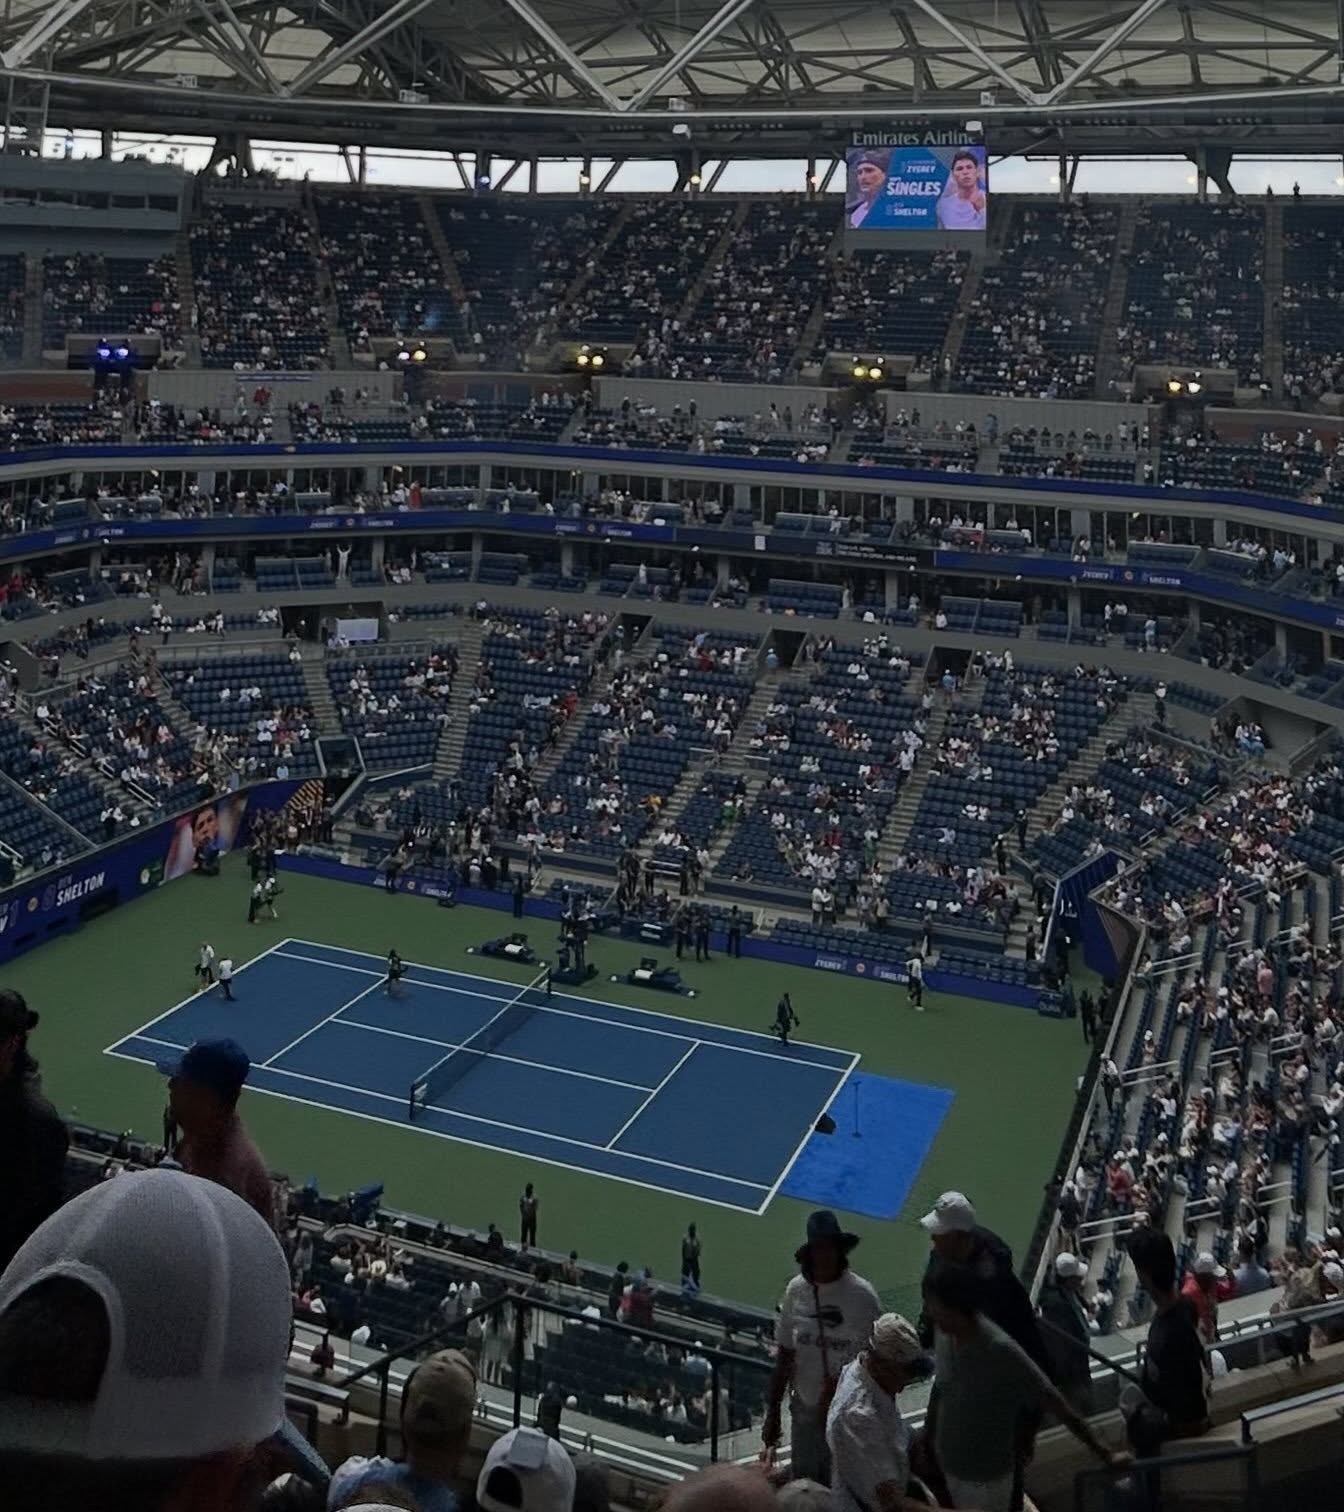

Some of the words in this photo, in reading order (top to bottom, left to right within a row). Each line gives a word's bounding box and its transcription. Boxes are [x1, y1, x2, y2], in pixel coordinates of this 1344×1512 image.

[852, 131, 921, 147] Emirates
[886, 181, 942, 197] SINGLES
[56, 871, 106, 908] SHELTON
